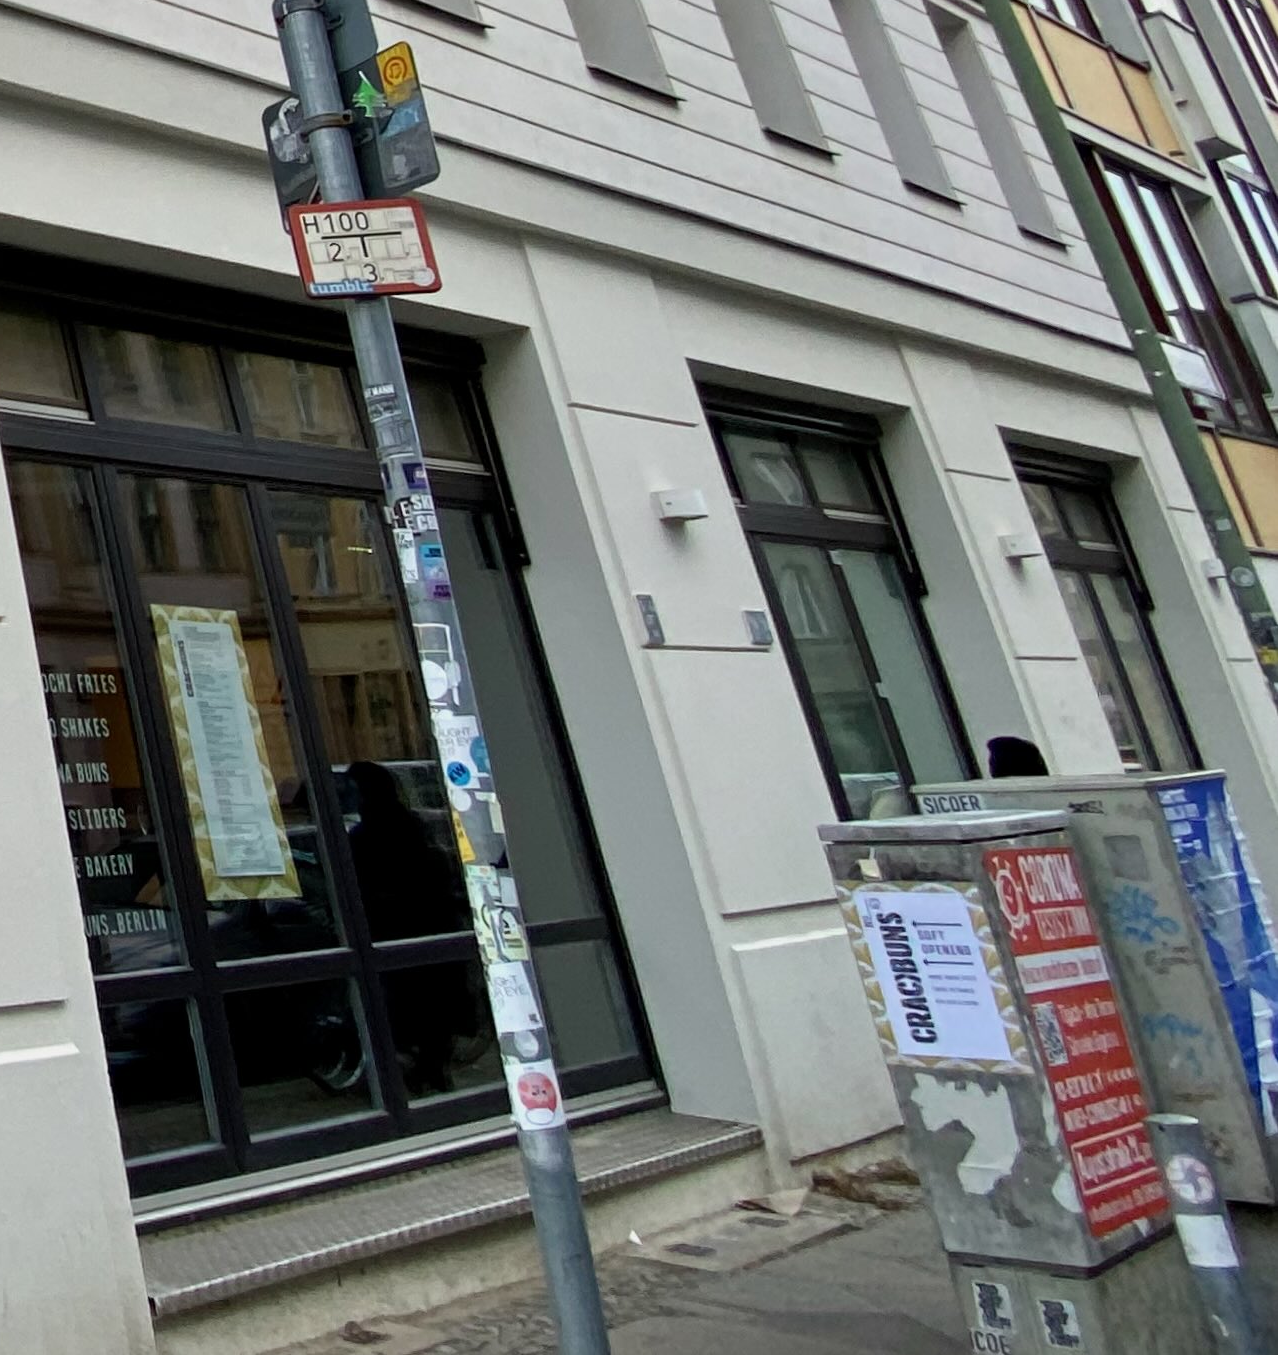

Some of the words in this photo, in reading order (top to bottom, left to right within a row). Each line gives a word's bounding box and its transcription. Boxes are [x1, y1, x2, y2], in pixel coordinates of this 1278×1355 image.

[77, 673, 117, 694] FRIES
[60, 717, 110, 739] SHAKES
[75, 762, 110, 784] BUNS
[68, 807, 127, 831] SLIDERS
[84, 853, 135, 878] BAKERY
